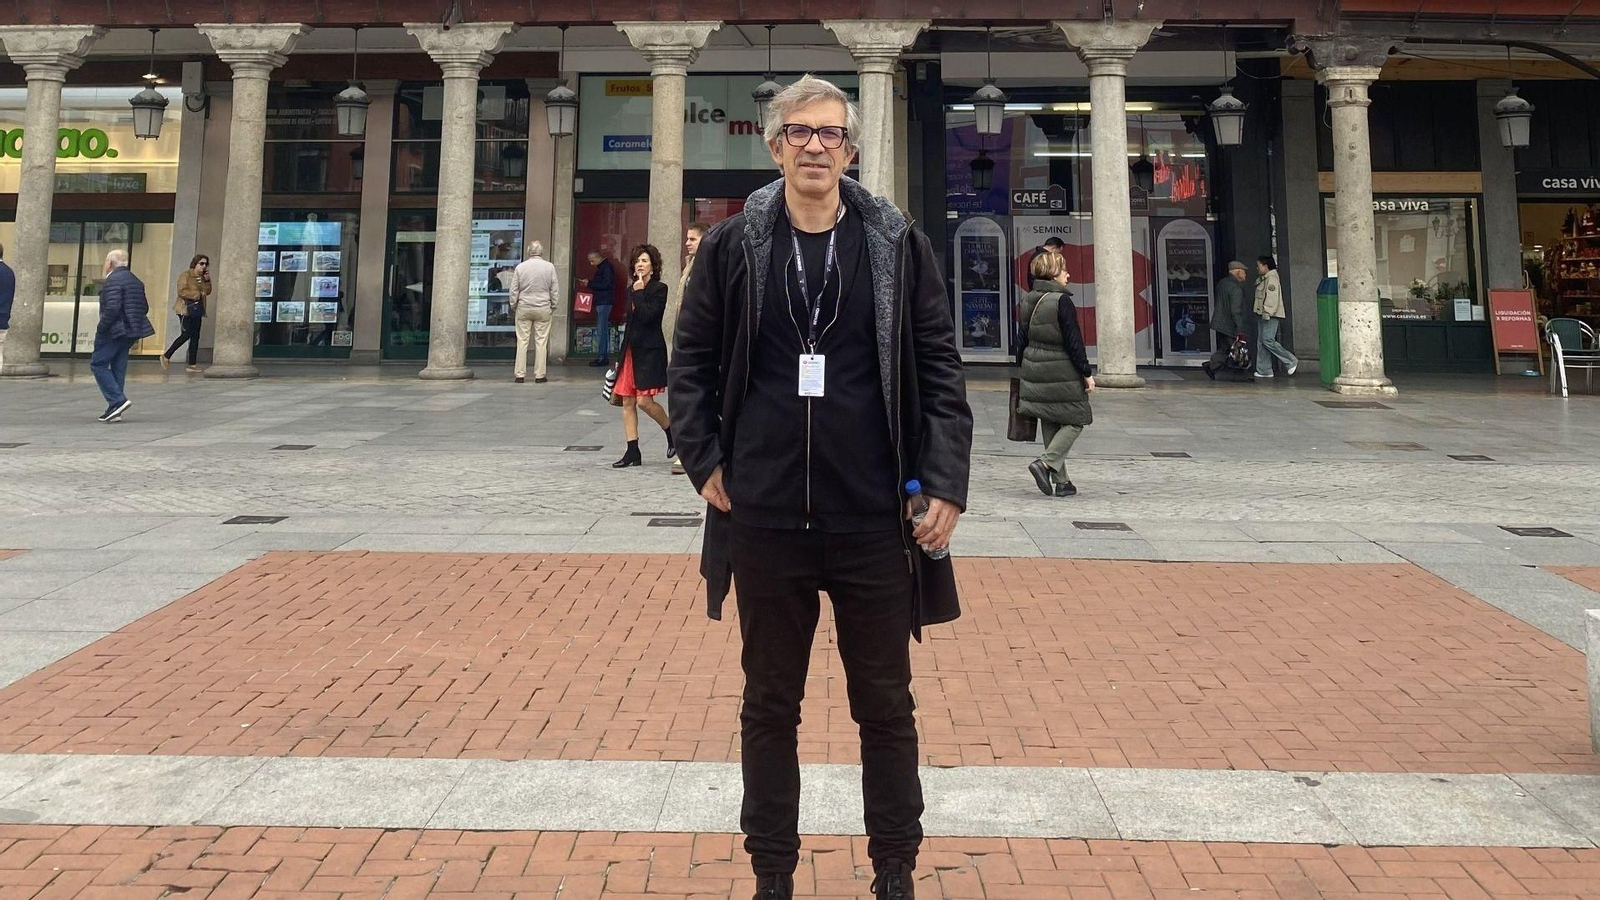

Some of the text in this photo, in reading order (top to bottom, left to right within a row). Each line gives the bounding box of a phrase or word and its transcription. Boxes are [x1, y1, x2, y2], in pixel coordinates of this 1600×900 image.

[610, 84, 641, 92] Frutos
[684, 102, 726, 124] lce
[1542, 175, 1600, 189] casa viv
[1013, 189, 1047, 204] CAFÉ
[1372, 199, 1429, 211] asa viva
[1033, 225, 1072, 234] SEMINCI
